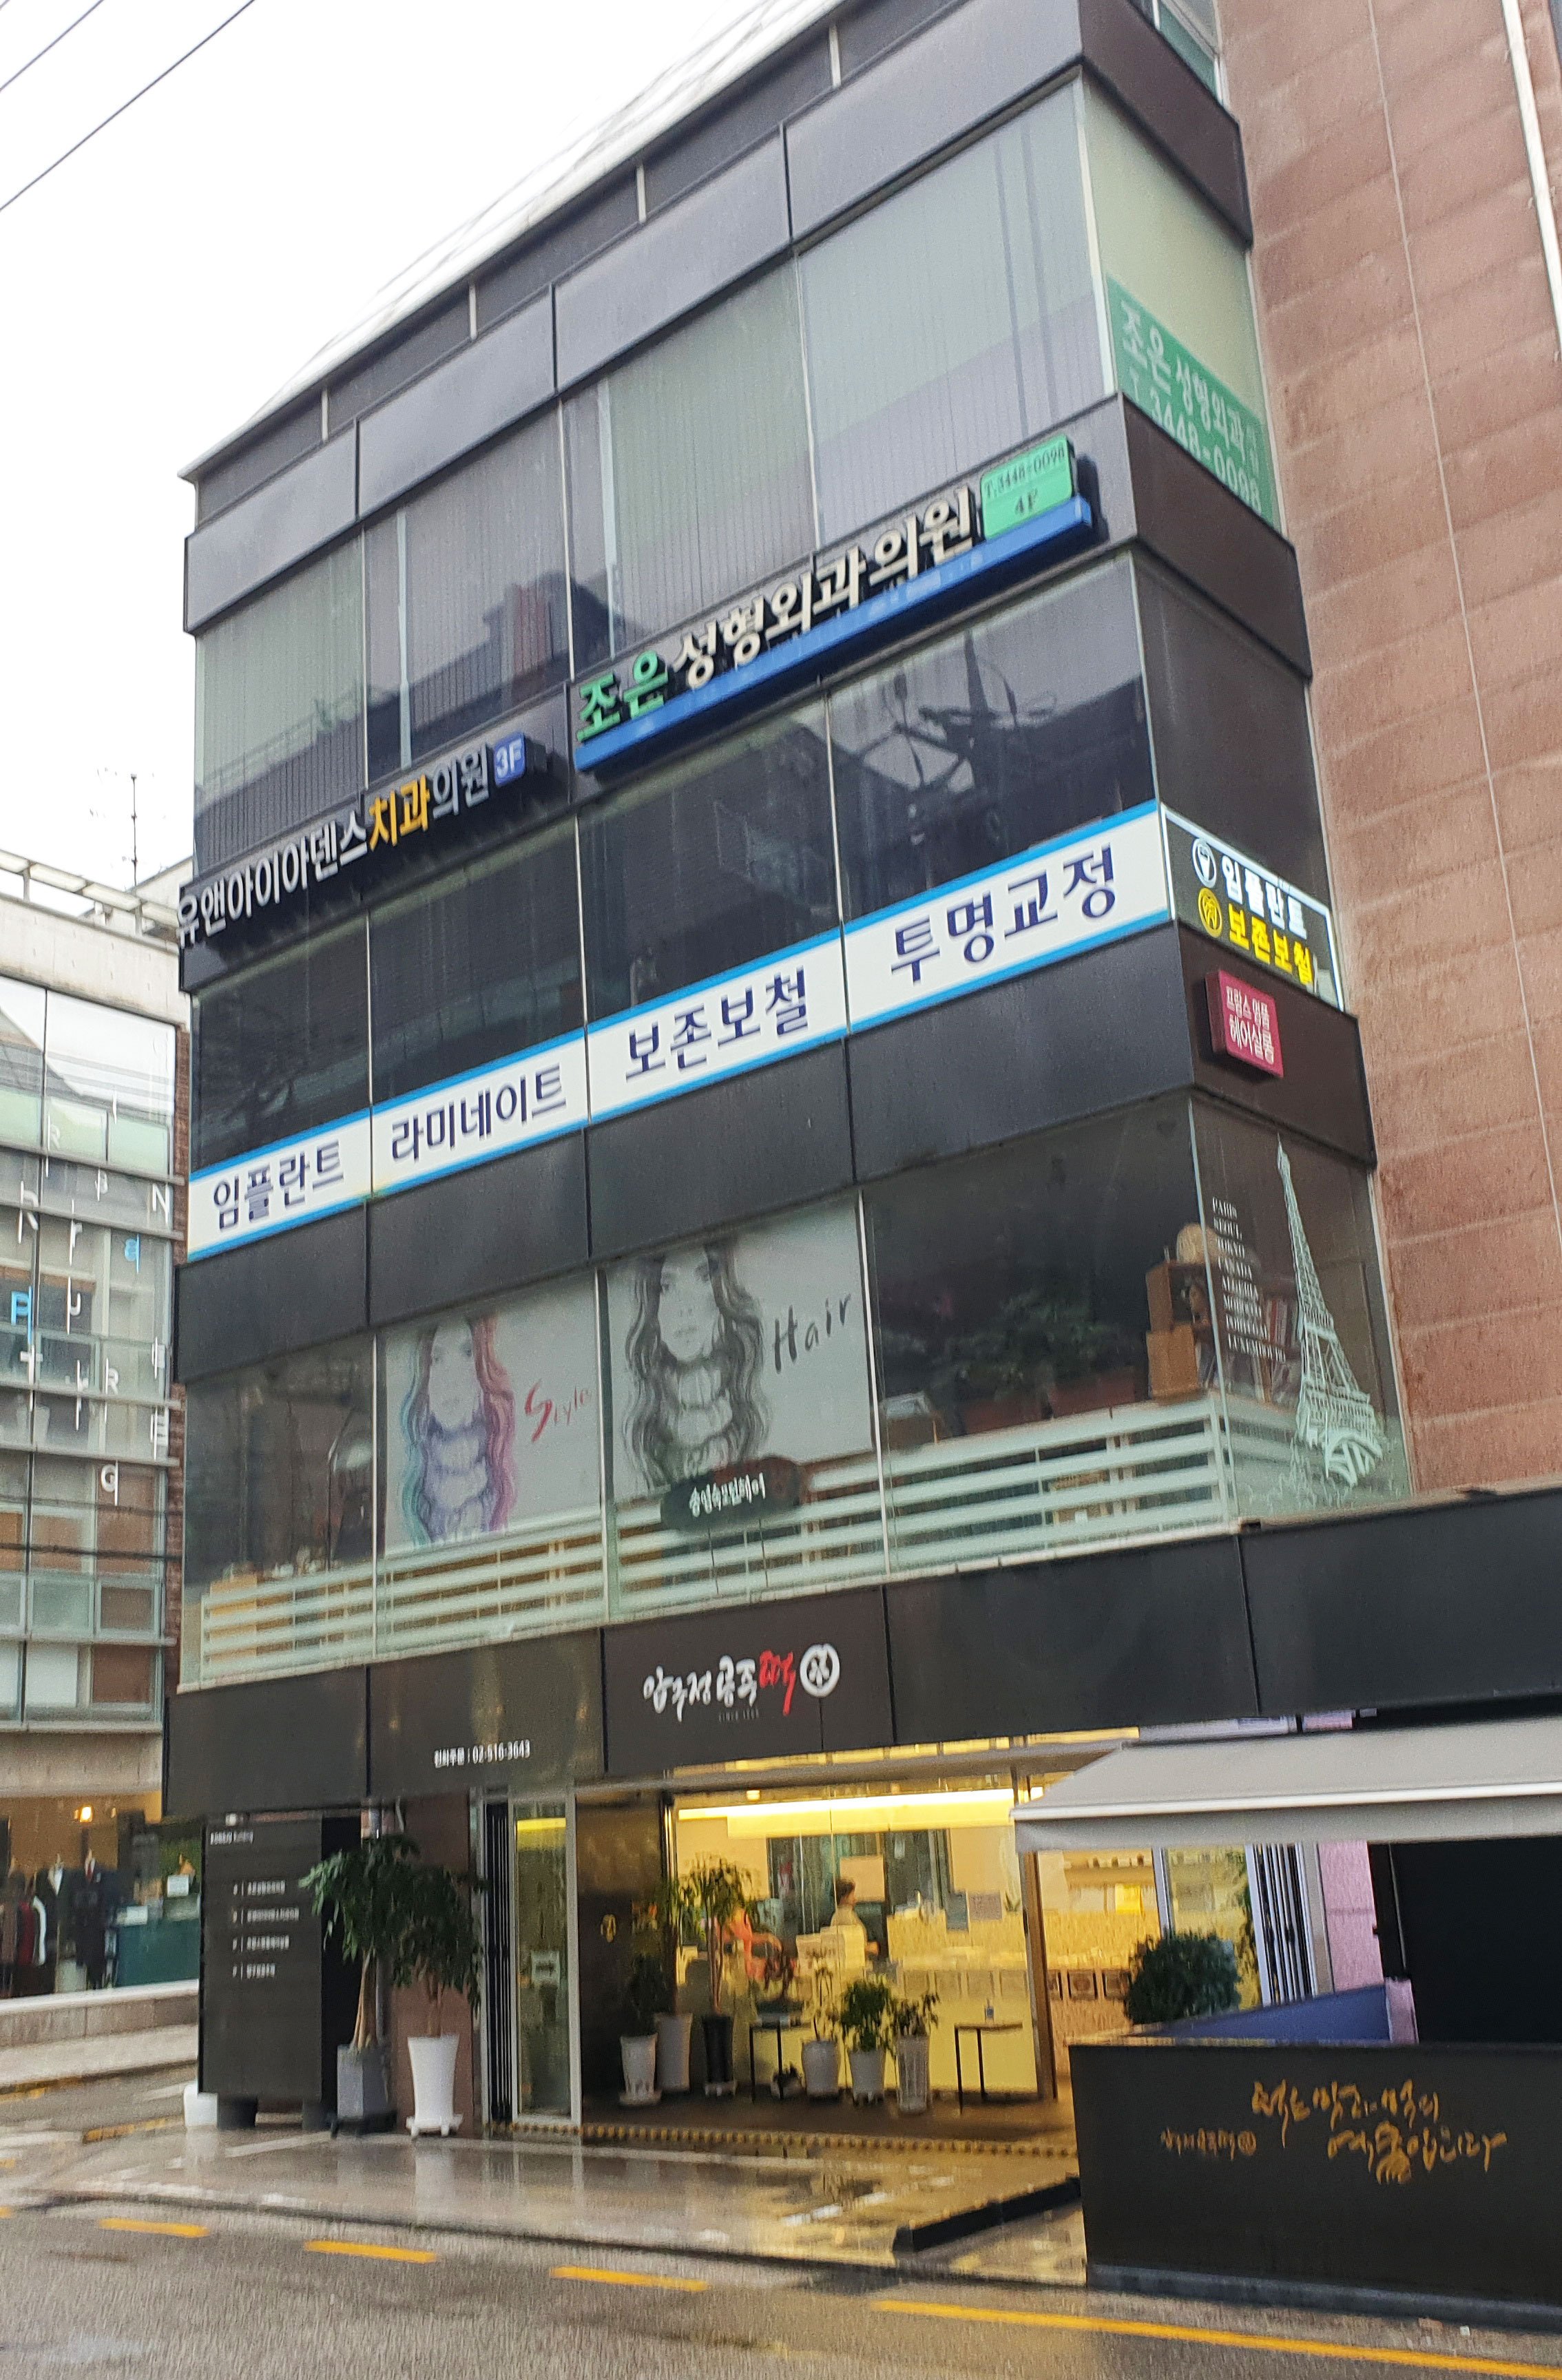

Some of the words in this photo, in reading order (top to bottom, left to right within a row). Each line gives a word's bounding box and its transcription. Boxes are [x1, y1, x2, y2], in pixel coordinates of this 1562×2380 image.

[1121, 300, 1172, 395] 조은
[1014, 488, 1039, 514] 4F
[577, 650, 669, 742] 조은
[672, 484, 973, 689] 성형외과의원
[494, 741, 522, 777] 3F
[891, 842, 1116, 986] 투명교정
[1221, 855, 1307, 940] 임플란트
[1228, 903, 1313, 985] 보존보철
[625, 965, 809, 1082] 보존보철
[391, 1061, 567, 1162] 라미네이트
[214, 1138, 344, 1231] 임플란트
[773, 1292, 851, 1375] Hair
[525, 1377, 592, 1442] Style
